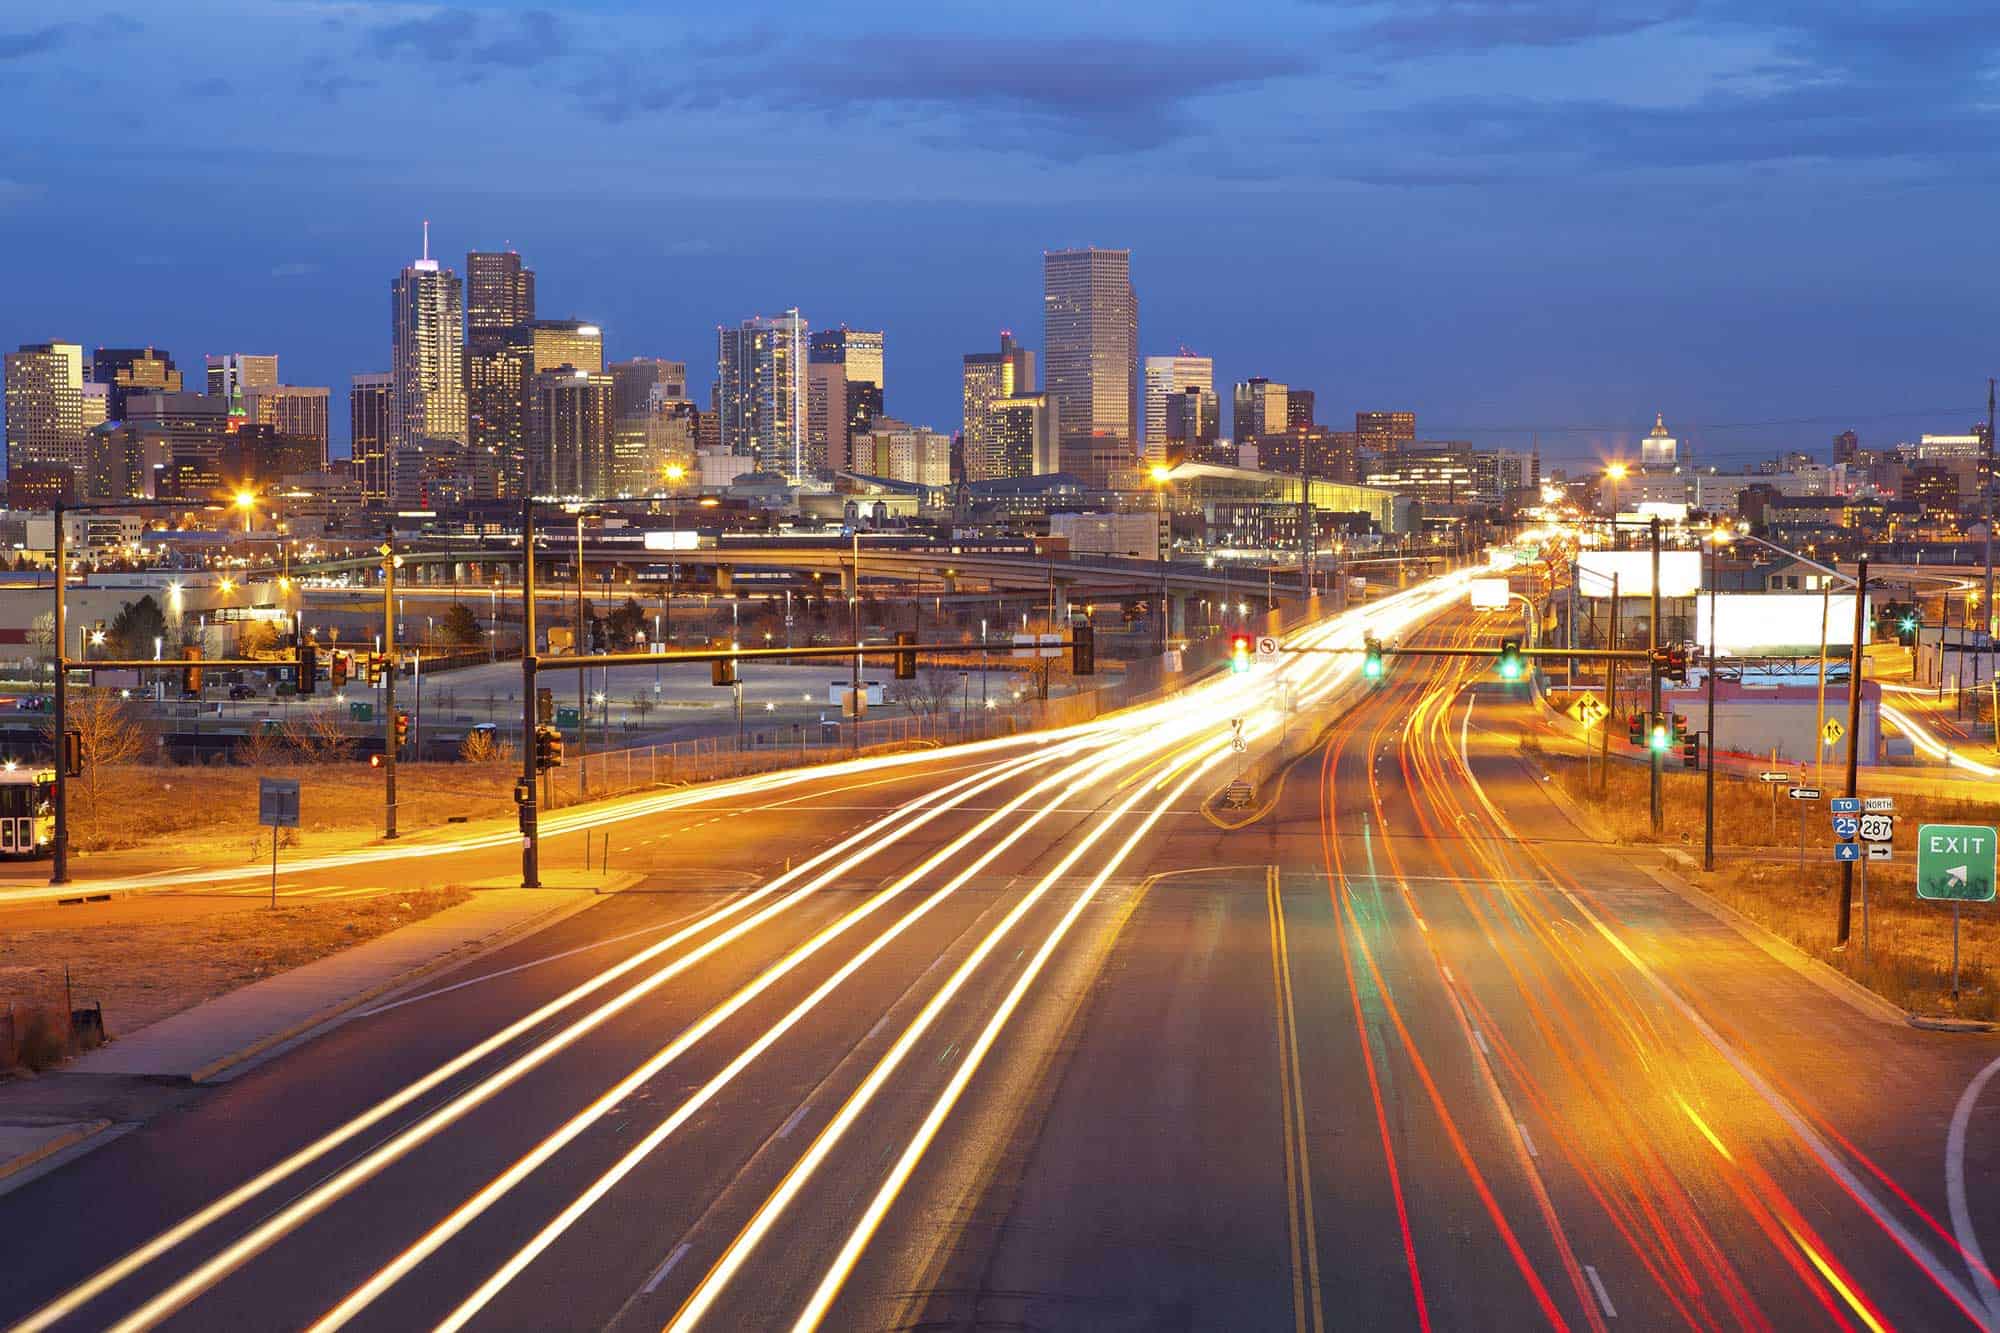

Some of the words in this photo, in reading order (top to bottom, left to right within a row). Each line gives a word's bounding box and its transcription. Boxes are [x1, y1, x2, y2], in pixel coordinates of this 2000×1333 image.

[1839, 801, 1852, 809] TO
[1866, 800, 1892, 808] NORTH
[1836, 818, 1857, 834] 25
[1863, 820, 1889, 835] 287
[1930, 836, 1985, 854] EXIT
